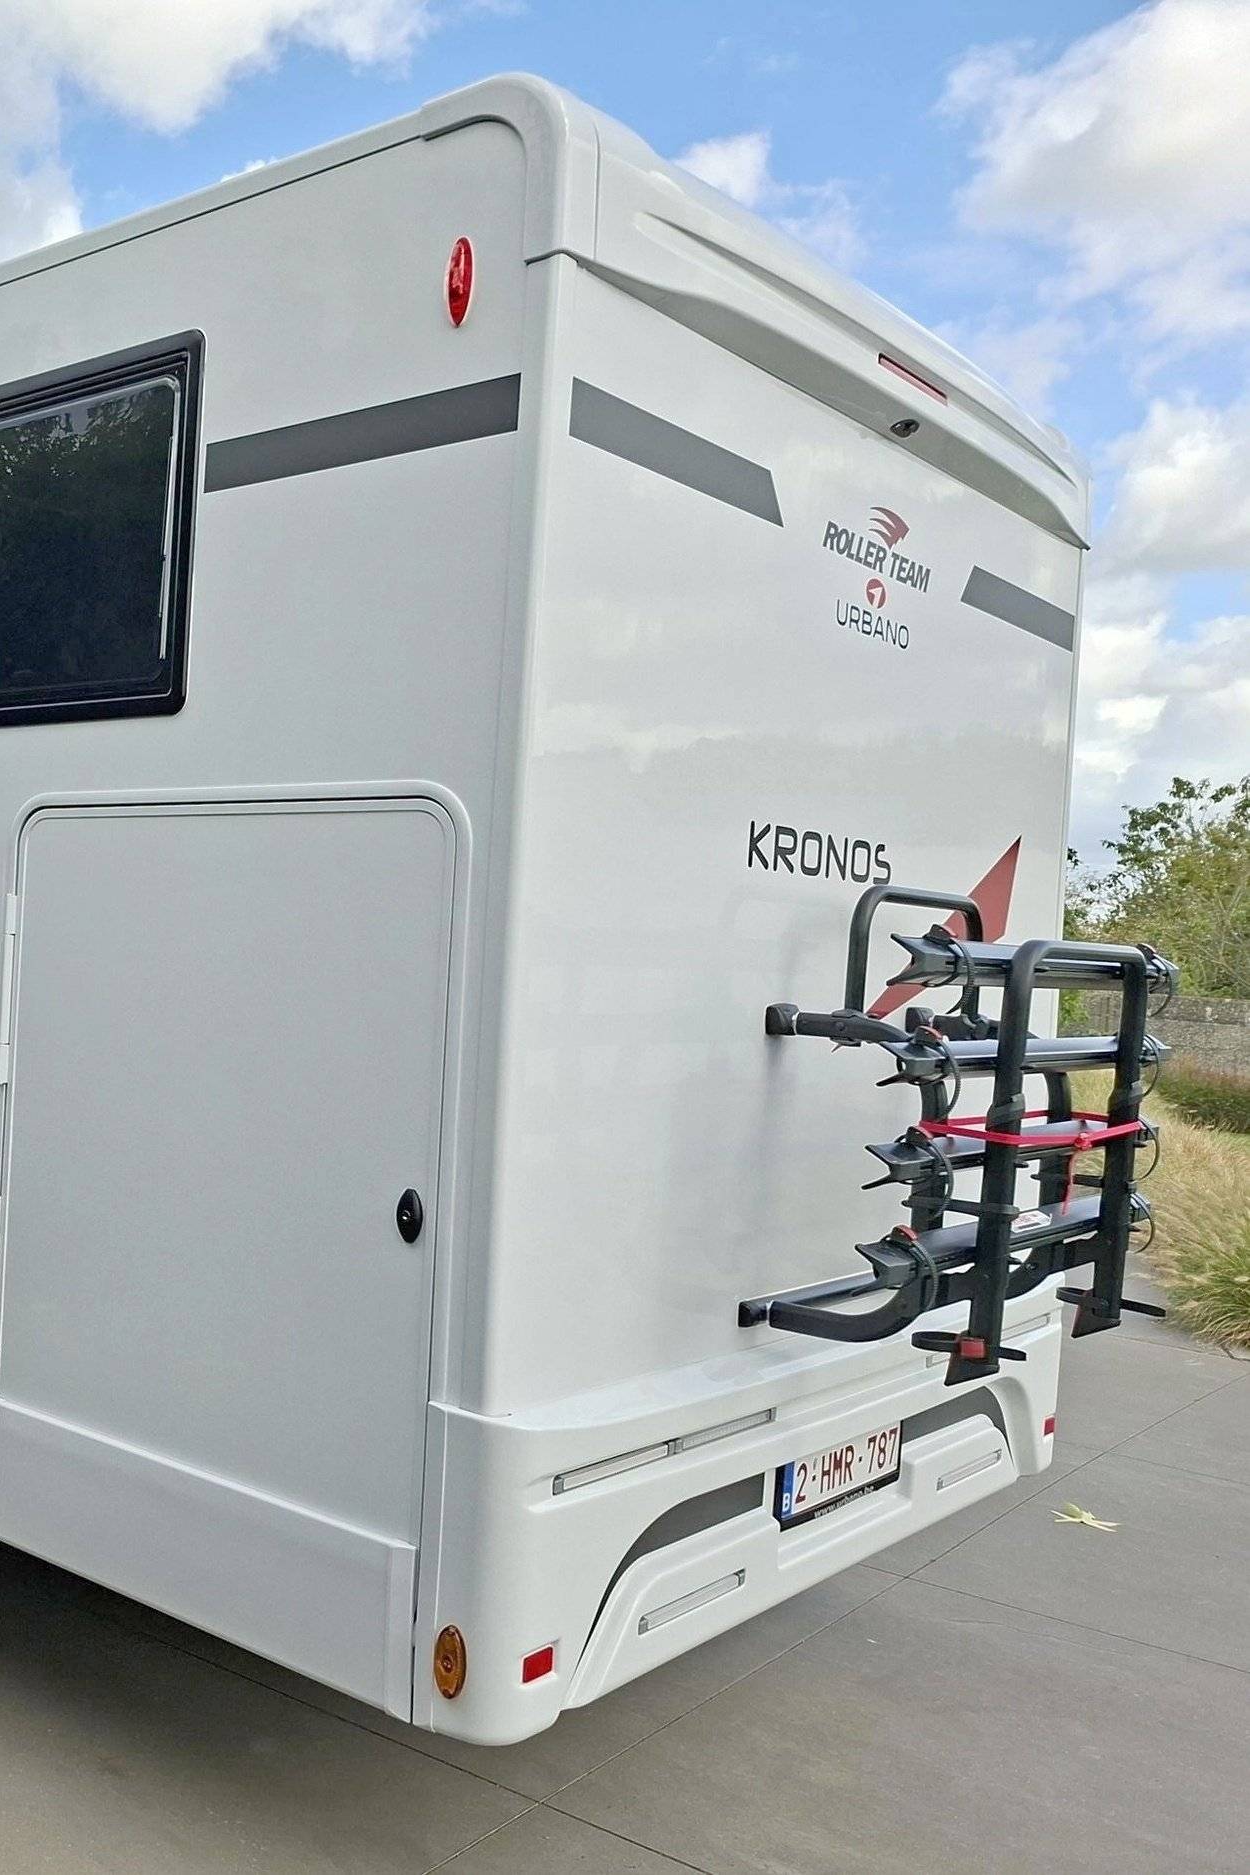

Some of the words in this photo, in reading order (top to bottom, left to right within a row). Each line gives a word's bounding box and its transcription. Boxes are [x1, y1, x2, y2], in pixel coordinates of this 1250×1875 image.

[822, 520, 886, 574] ROLLER
[889, 551, 931, 593] TEAM
[836, 599, 910, 650] URBANO
[747, 820, 892, 885] KRONOS
[781, 1493, 792, 1512] B
